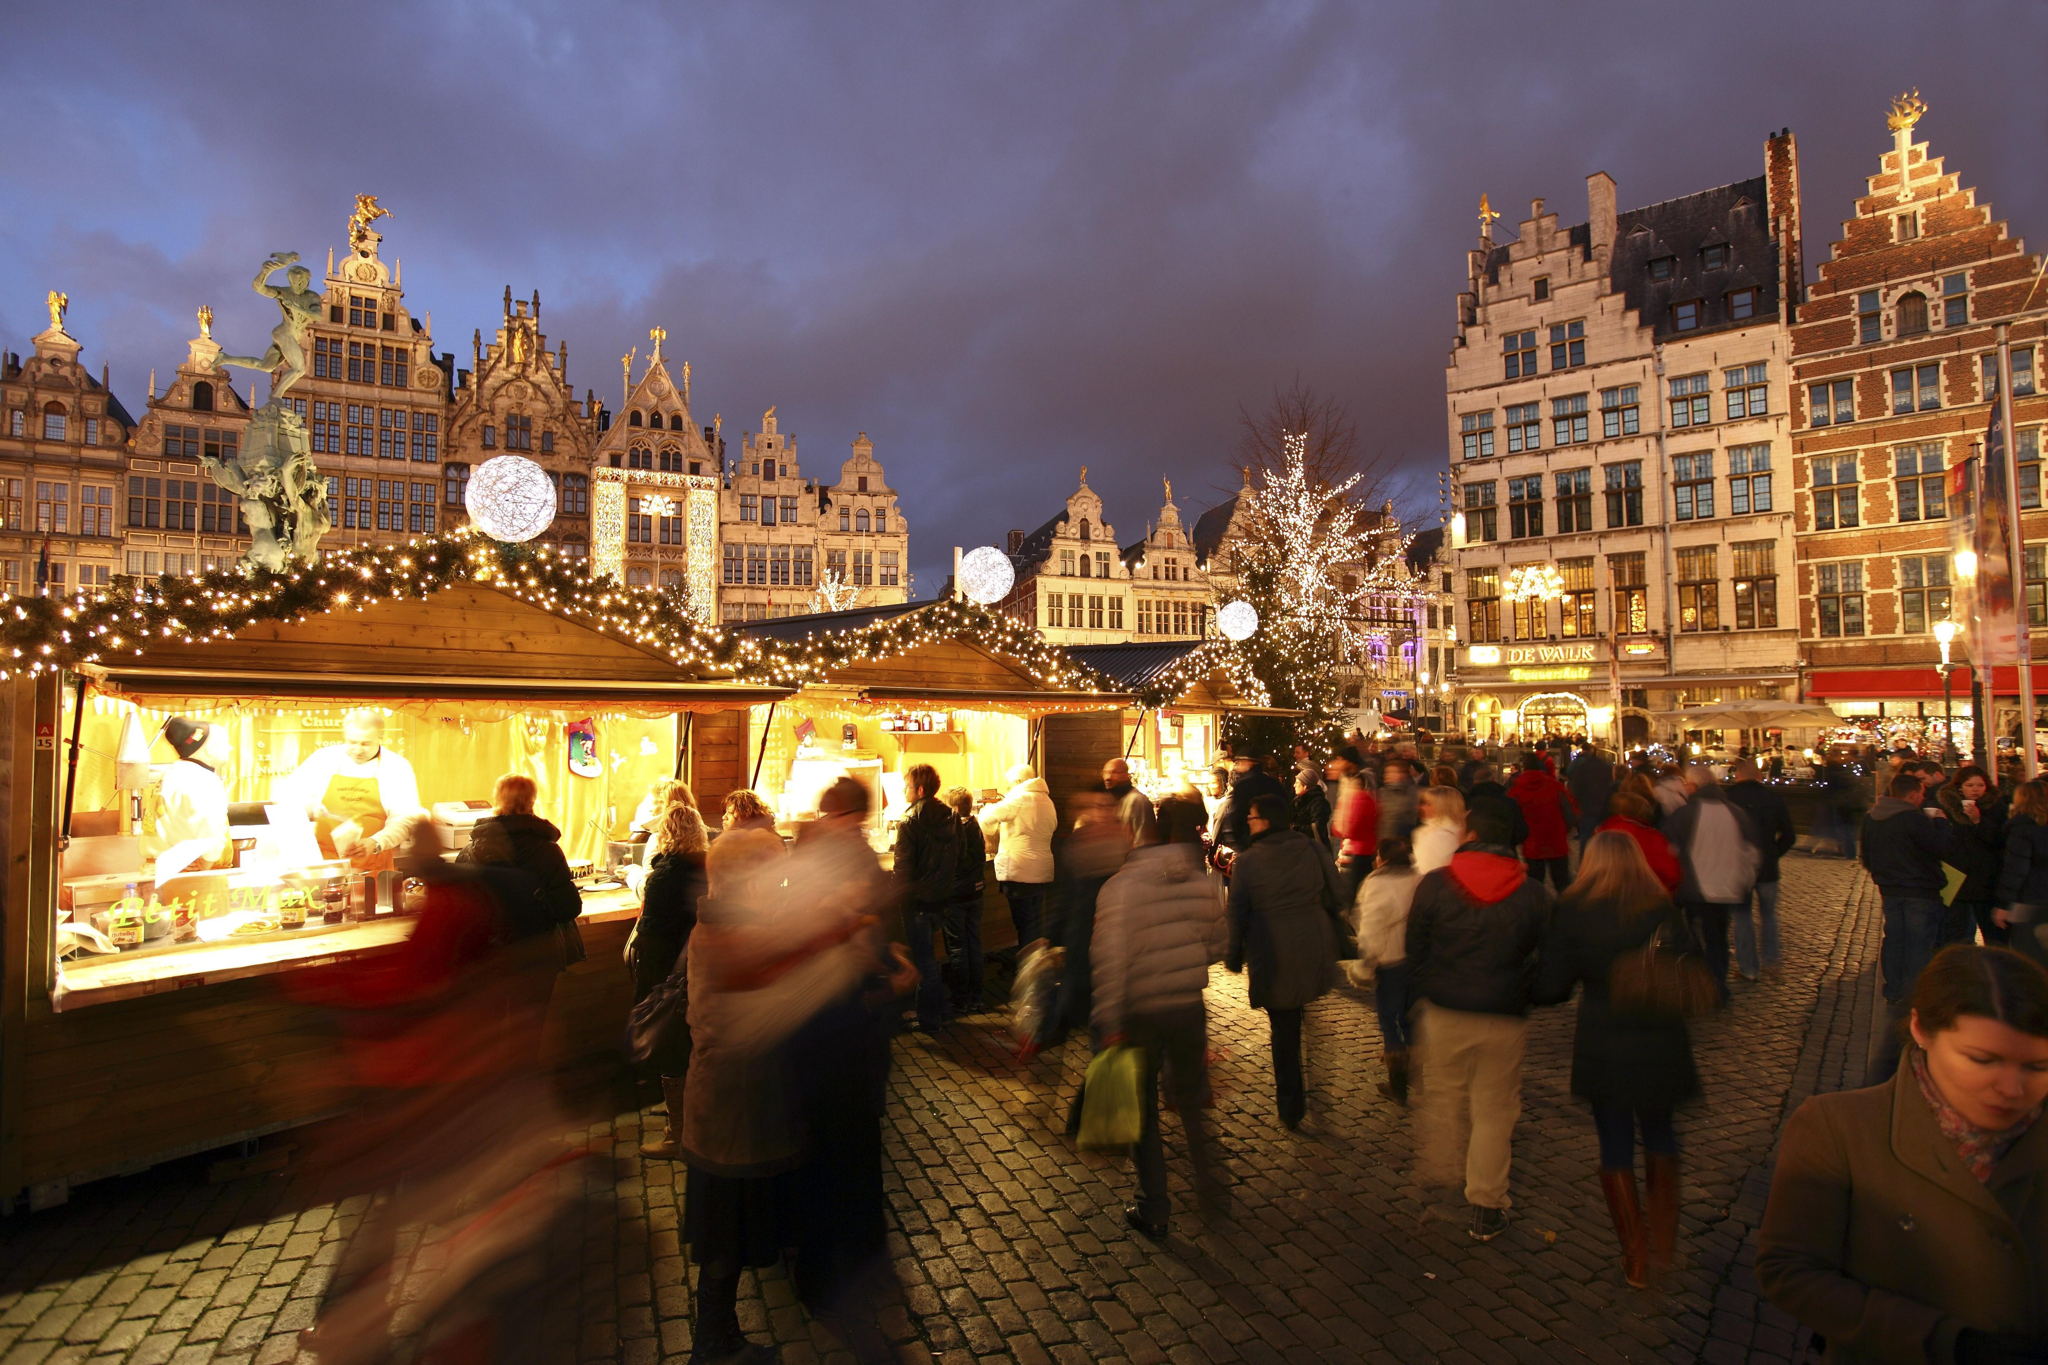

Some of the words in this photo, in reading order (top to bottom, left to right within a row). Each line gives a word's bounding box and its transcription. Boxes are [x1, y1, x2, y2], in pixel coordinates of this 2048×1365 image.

[1507, 647, 1535, 663] DE
[1539, 645, 1595, 662] VALK
[301, 717, 344, 727] Chur
[40, 727, 49, 736] A
[37, 739, 52, 748] 15
[107, 889, 218, 927] Petit
[230, 884, 326, 913] Max
